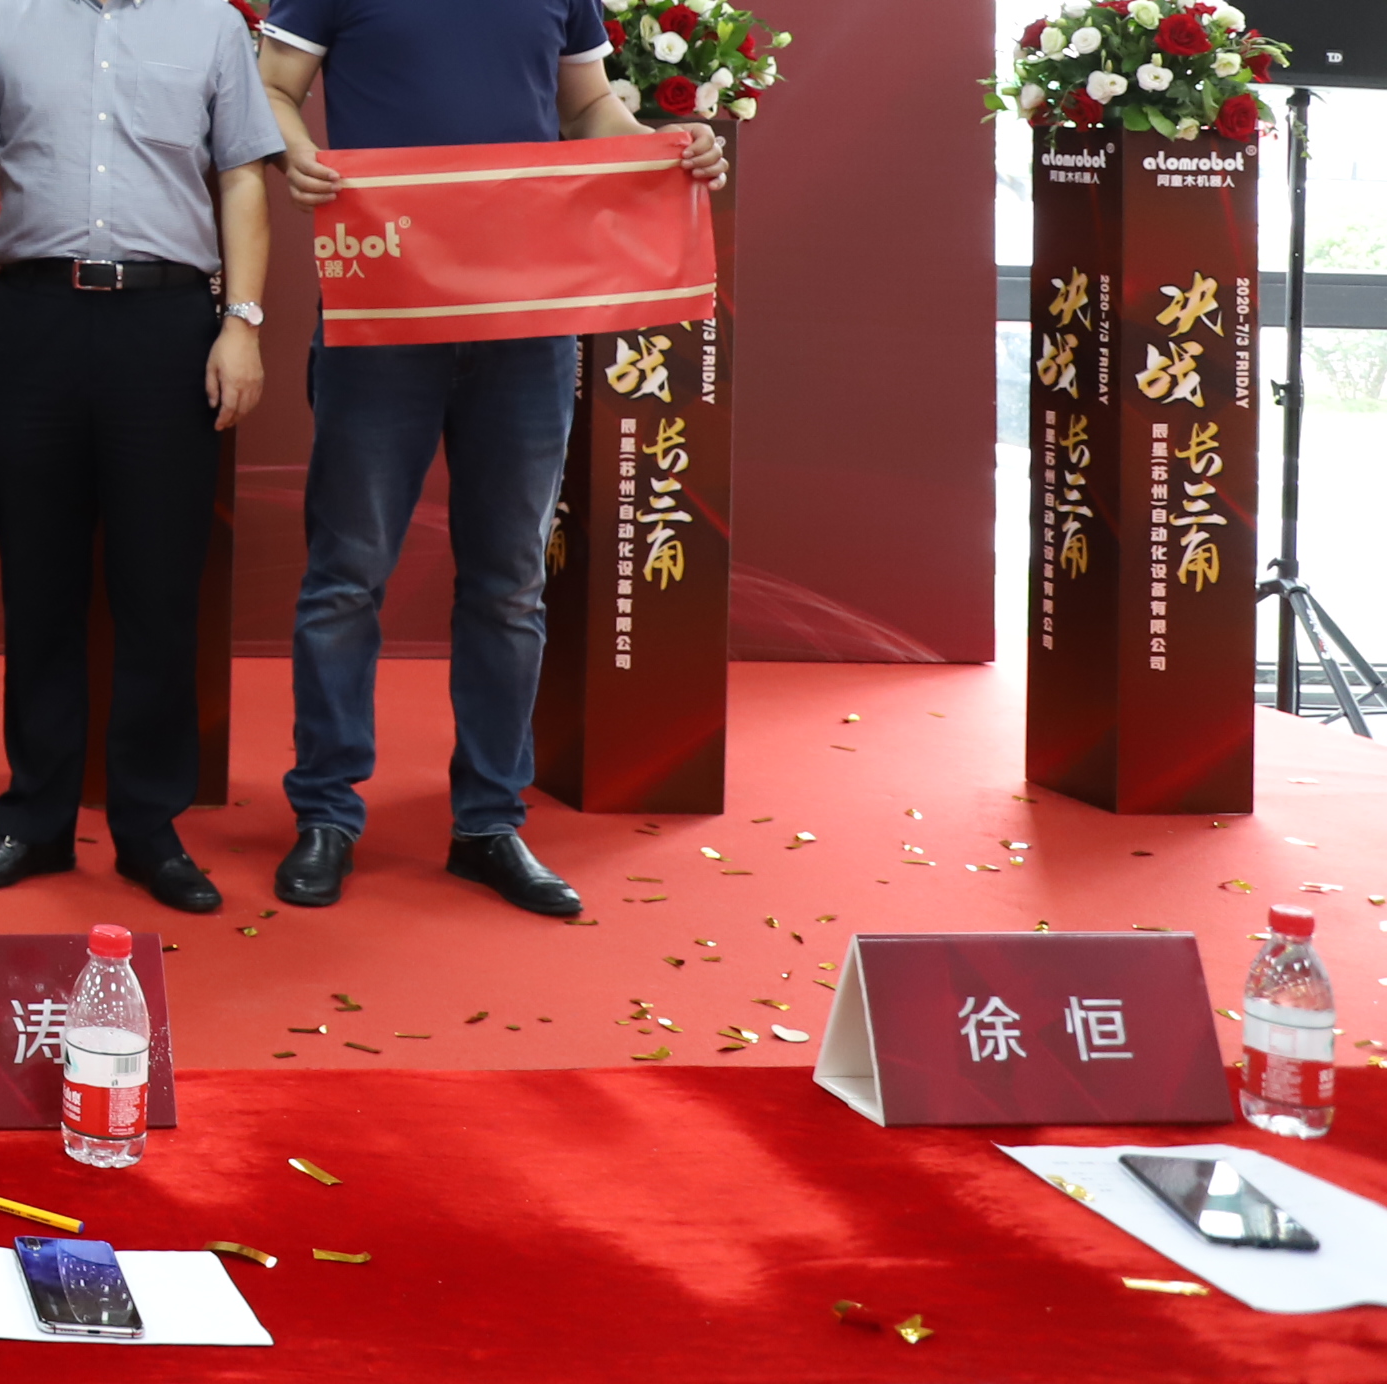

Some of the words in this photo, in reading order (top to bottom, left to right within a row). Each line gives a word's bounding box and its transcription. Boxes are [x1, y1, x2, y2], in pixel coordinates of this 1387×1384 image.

[1050, 170, 1100, 184] 阿童木机器人
[1143, 151, 1244, 172] atomrobot
[1156, 174, 1235, 188] 阿童木机器人
[1098, 274, 1110, 343] 2020-7/3
[1235, 277, 1250, 347] 2020-7/3
[1135, 271, 1224, 408] 决战
[702, 346, 716, 404] FRIDAY
[1098, 348, 1110, 405] FRIDAY
[1235, 351, 1249, 409] FRIDAY
[636, 417, 693, 591] 长三角
[1169, 422, 1227, 592] 长三角
